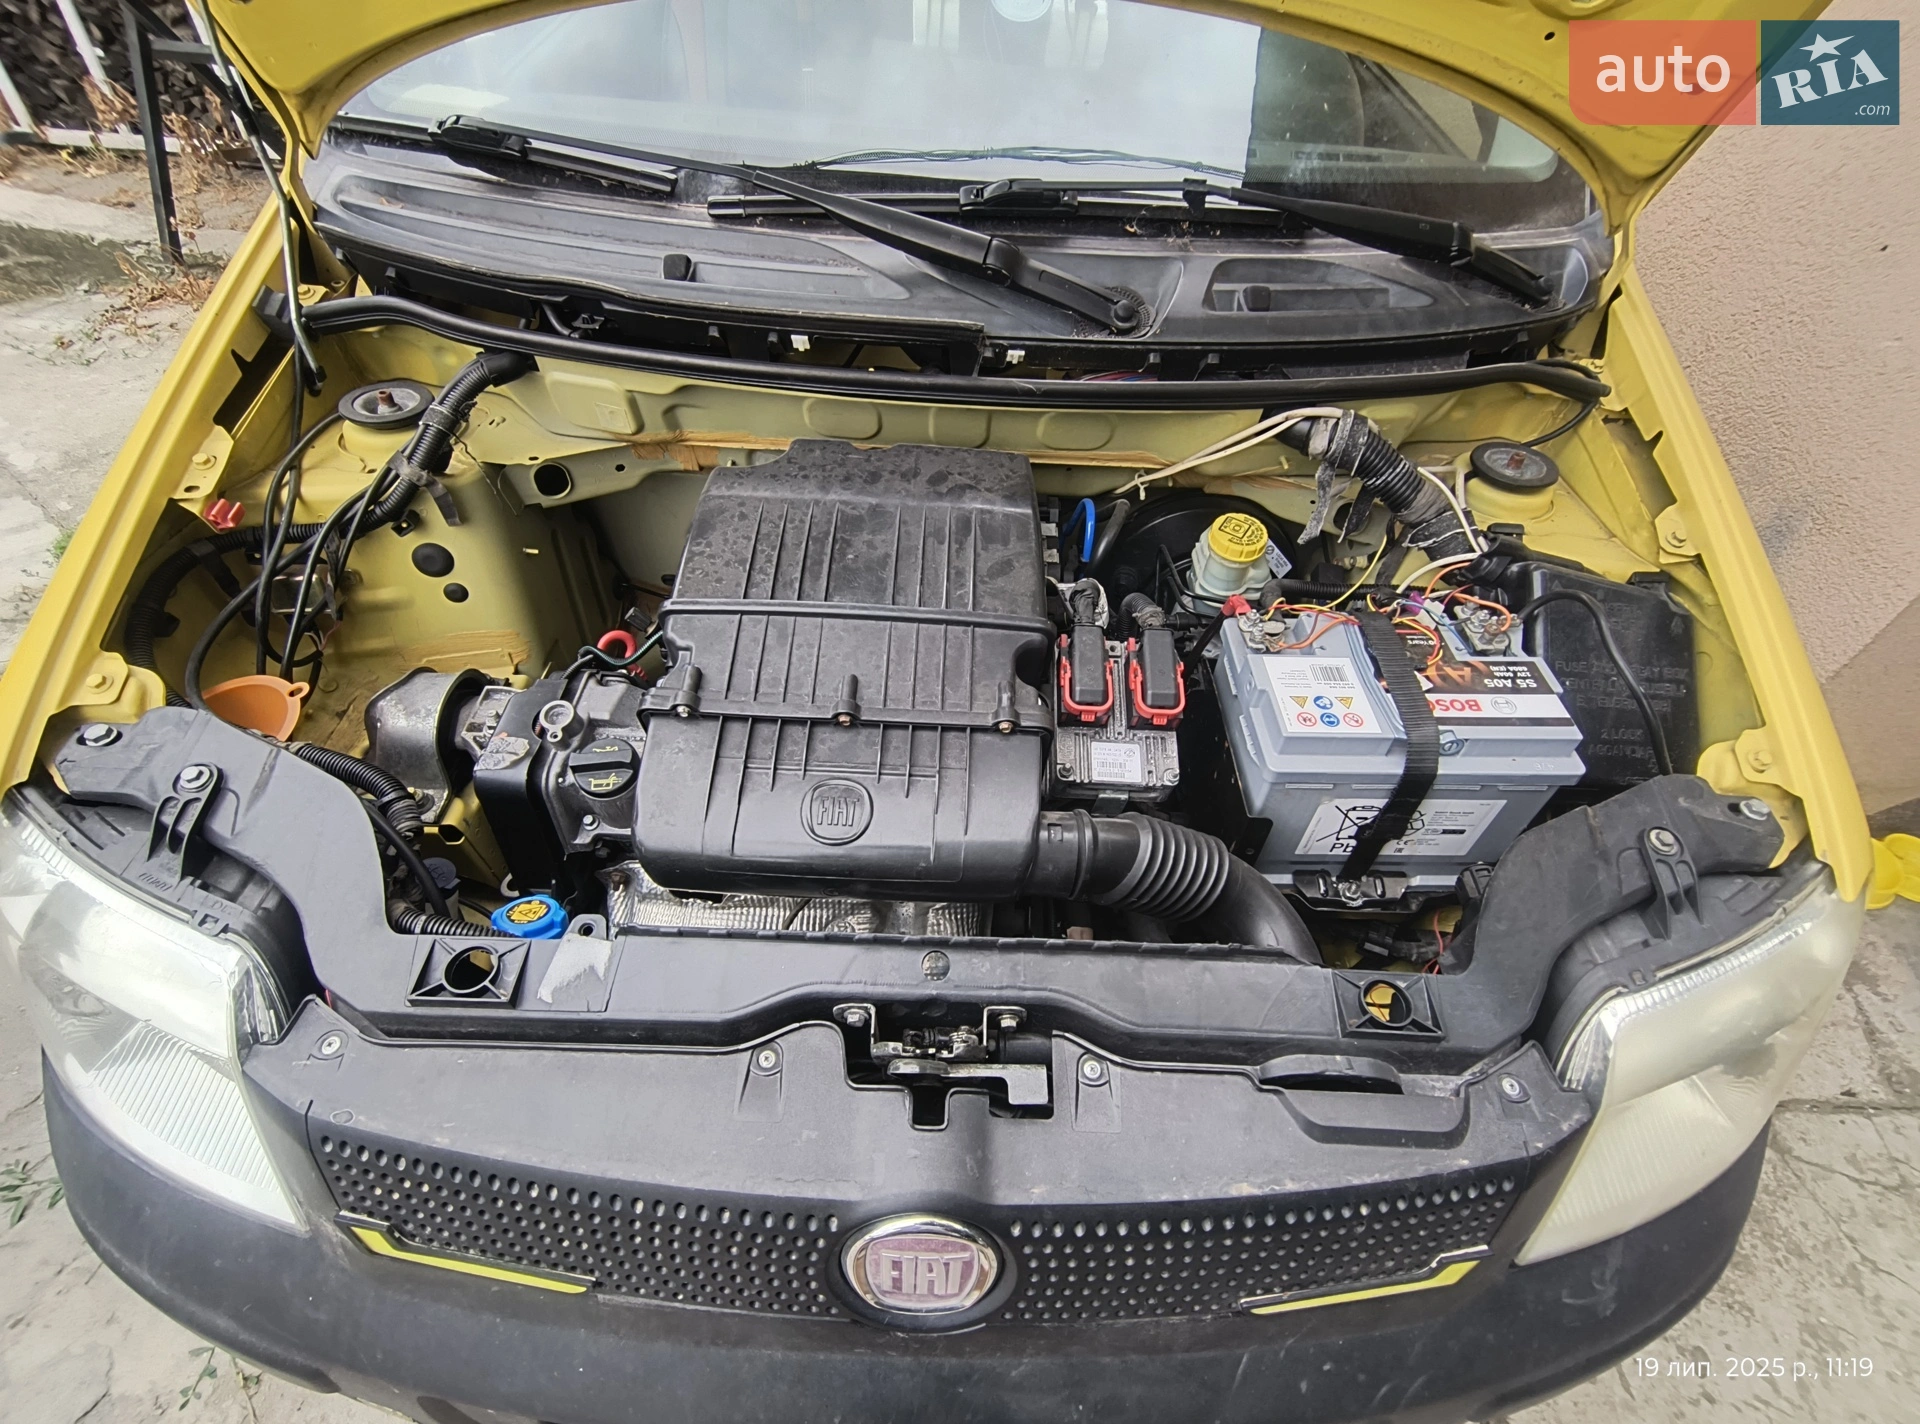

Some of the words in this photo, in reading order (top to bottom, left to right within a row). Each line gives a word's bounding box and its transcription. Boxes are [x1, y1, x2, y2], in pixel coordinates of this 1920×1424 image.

[1484, 678, 1512, 688] A05
[1516, 678, 1537, 688] S5
[817, 796, 859, 826] FIAT
[1329, 842, 1354, 853] Pb
[881, 1252, 970, 1295] FIAT
